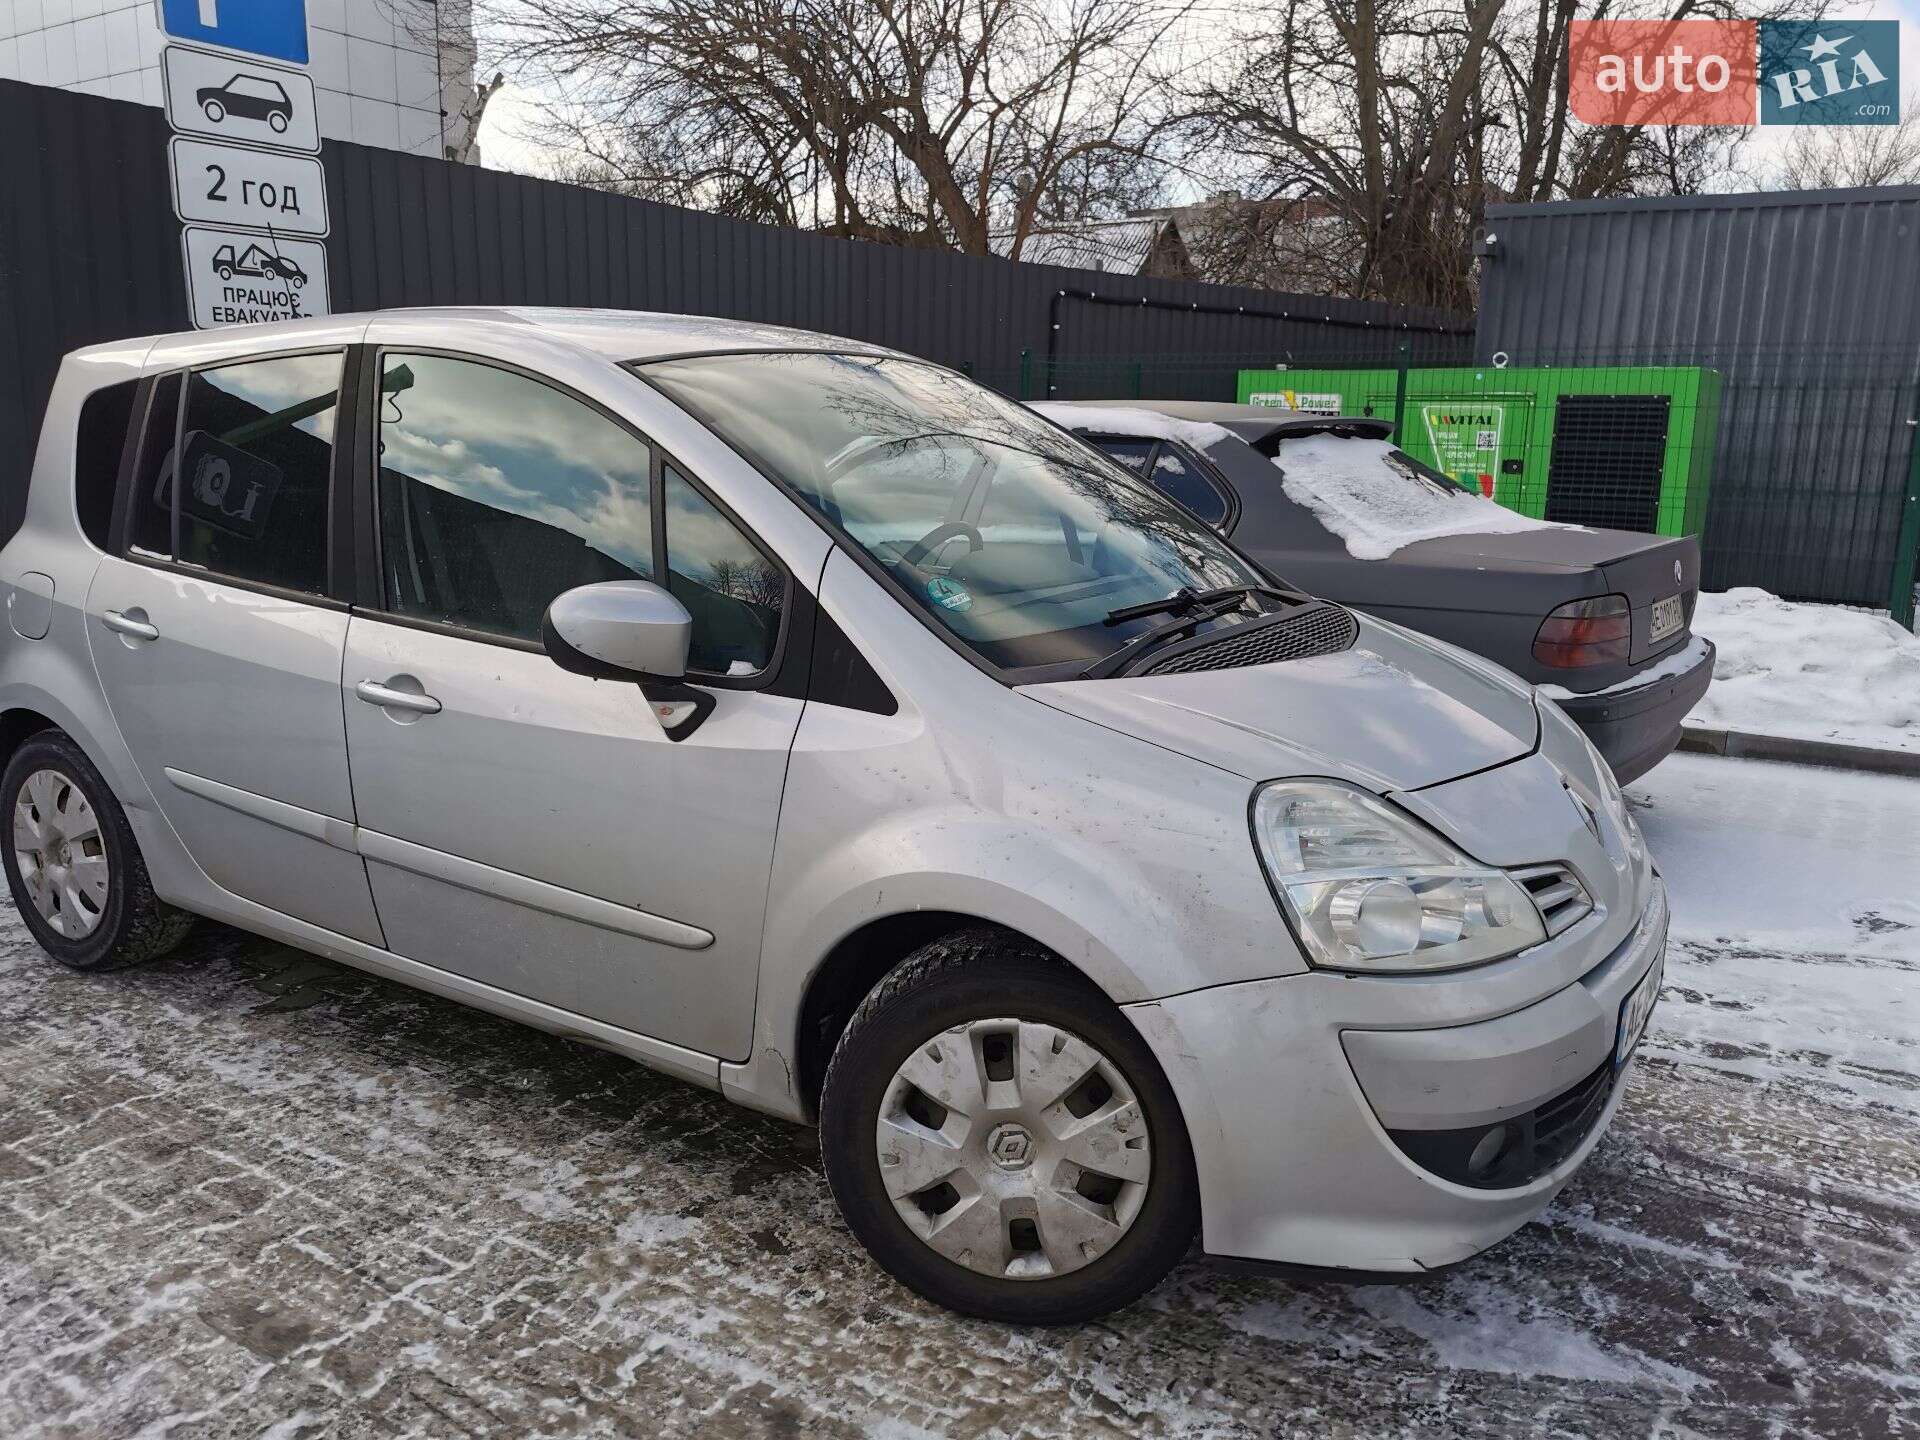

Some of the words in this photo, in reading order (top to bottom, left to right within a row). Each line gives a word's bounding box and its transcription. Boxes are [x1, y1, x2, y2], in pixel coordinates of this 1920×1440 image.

[205, 164, 228, 202] 2
[242, 180, 301, 215] год
[223, 286, 301, 309] ПРАЦЮЄ
[1252, 396, 1283, 408] Green
[1301, 396, 1337, 409] Power
